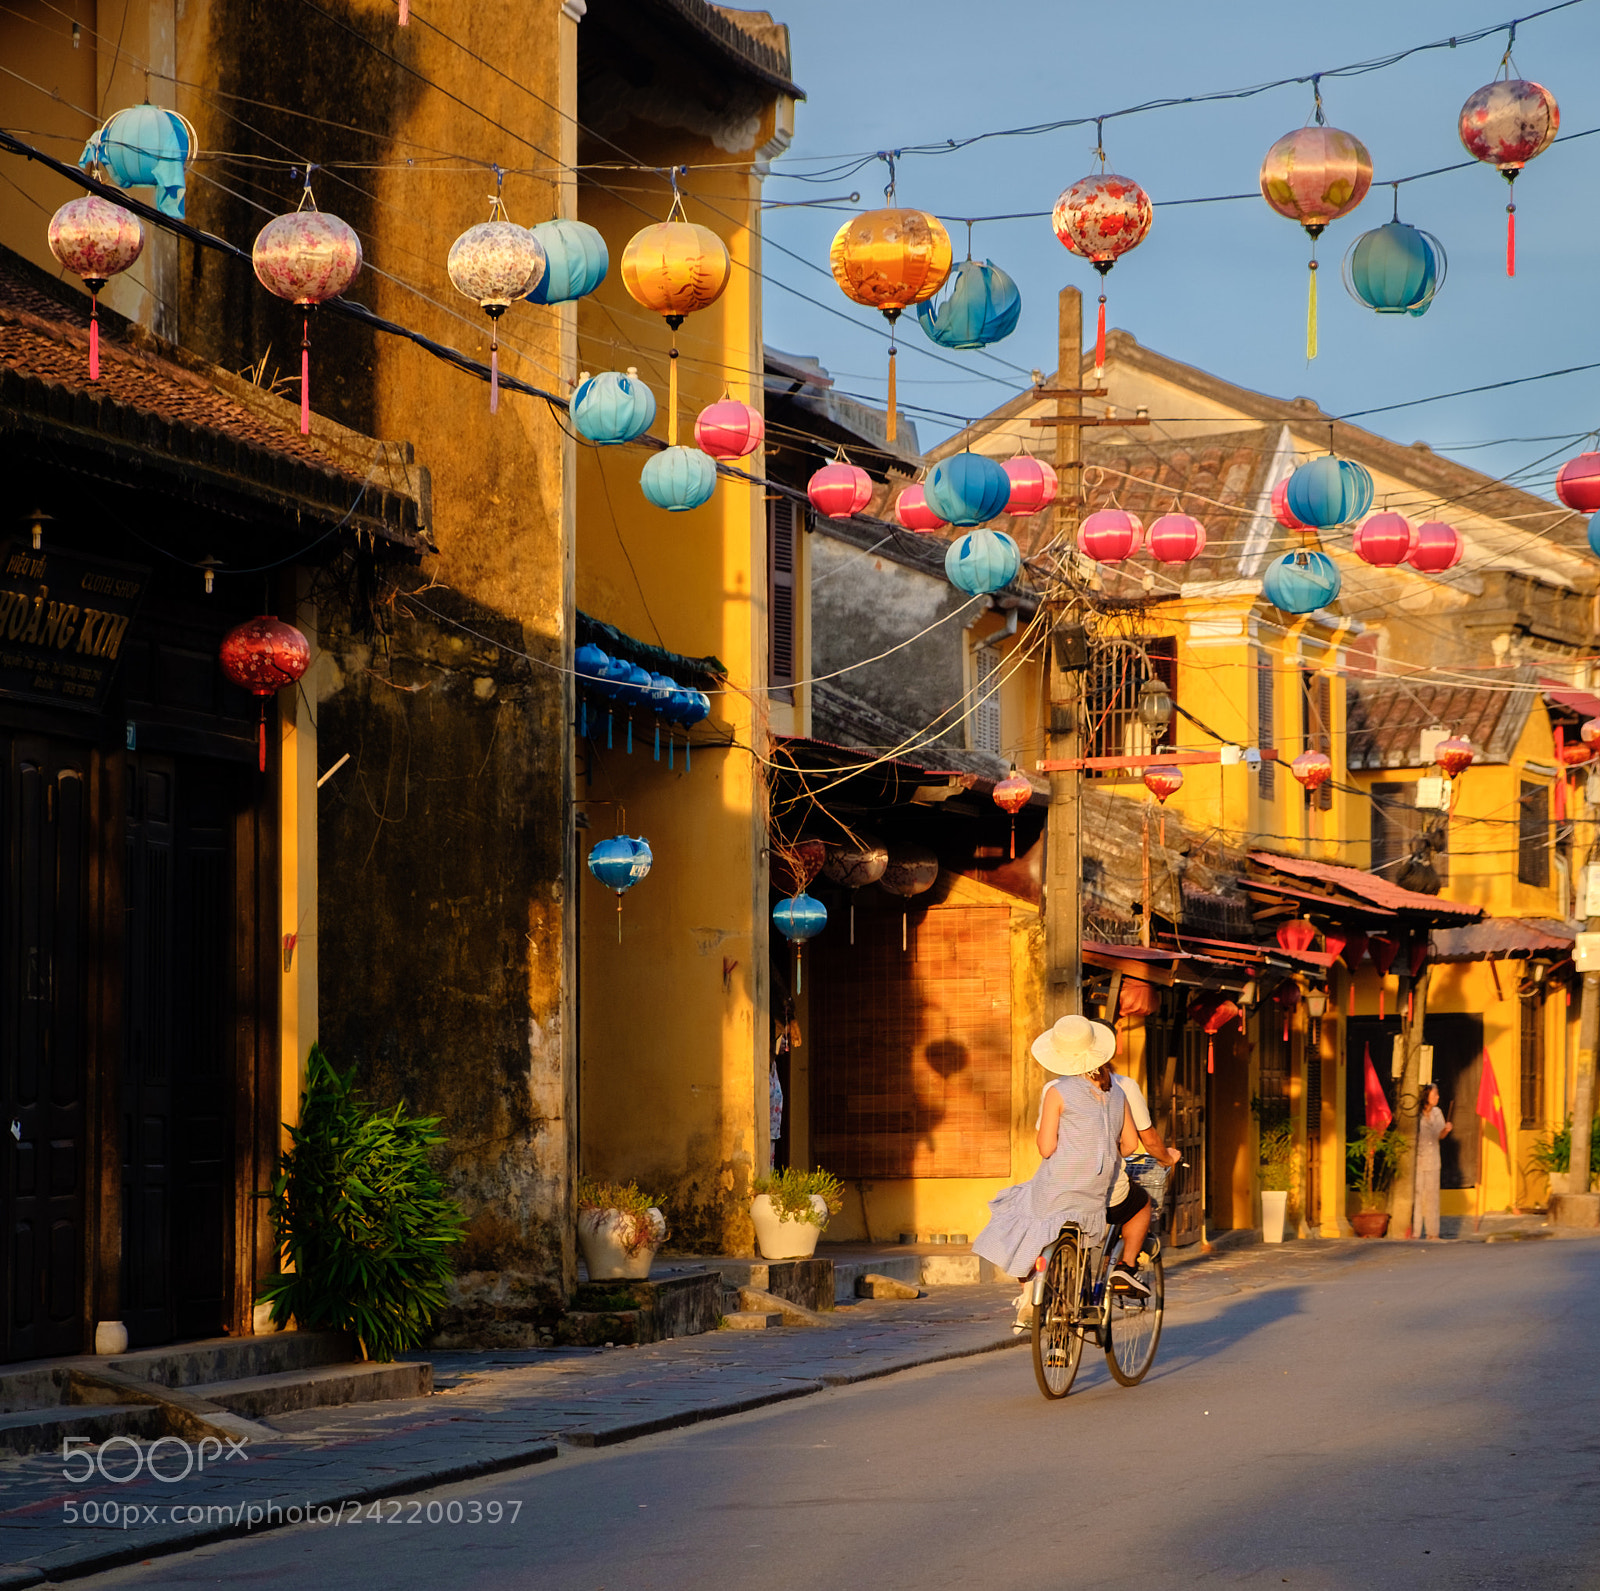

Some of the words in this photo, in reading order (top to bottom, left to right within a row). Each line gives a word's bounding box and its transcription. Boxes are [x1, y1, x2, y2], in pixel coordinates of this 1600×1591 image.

[81, 572, 114, 594] CLOTH
[113, 580, 140, 599] SHOP
[75, 609, 130, 660] KIM
